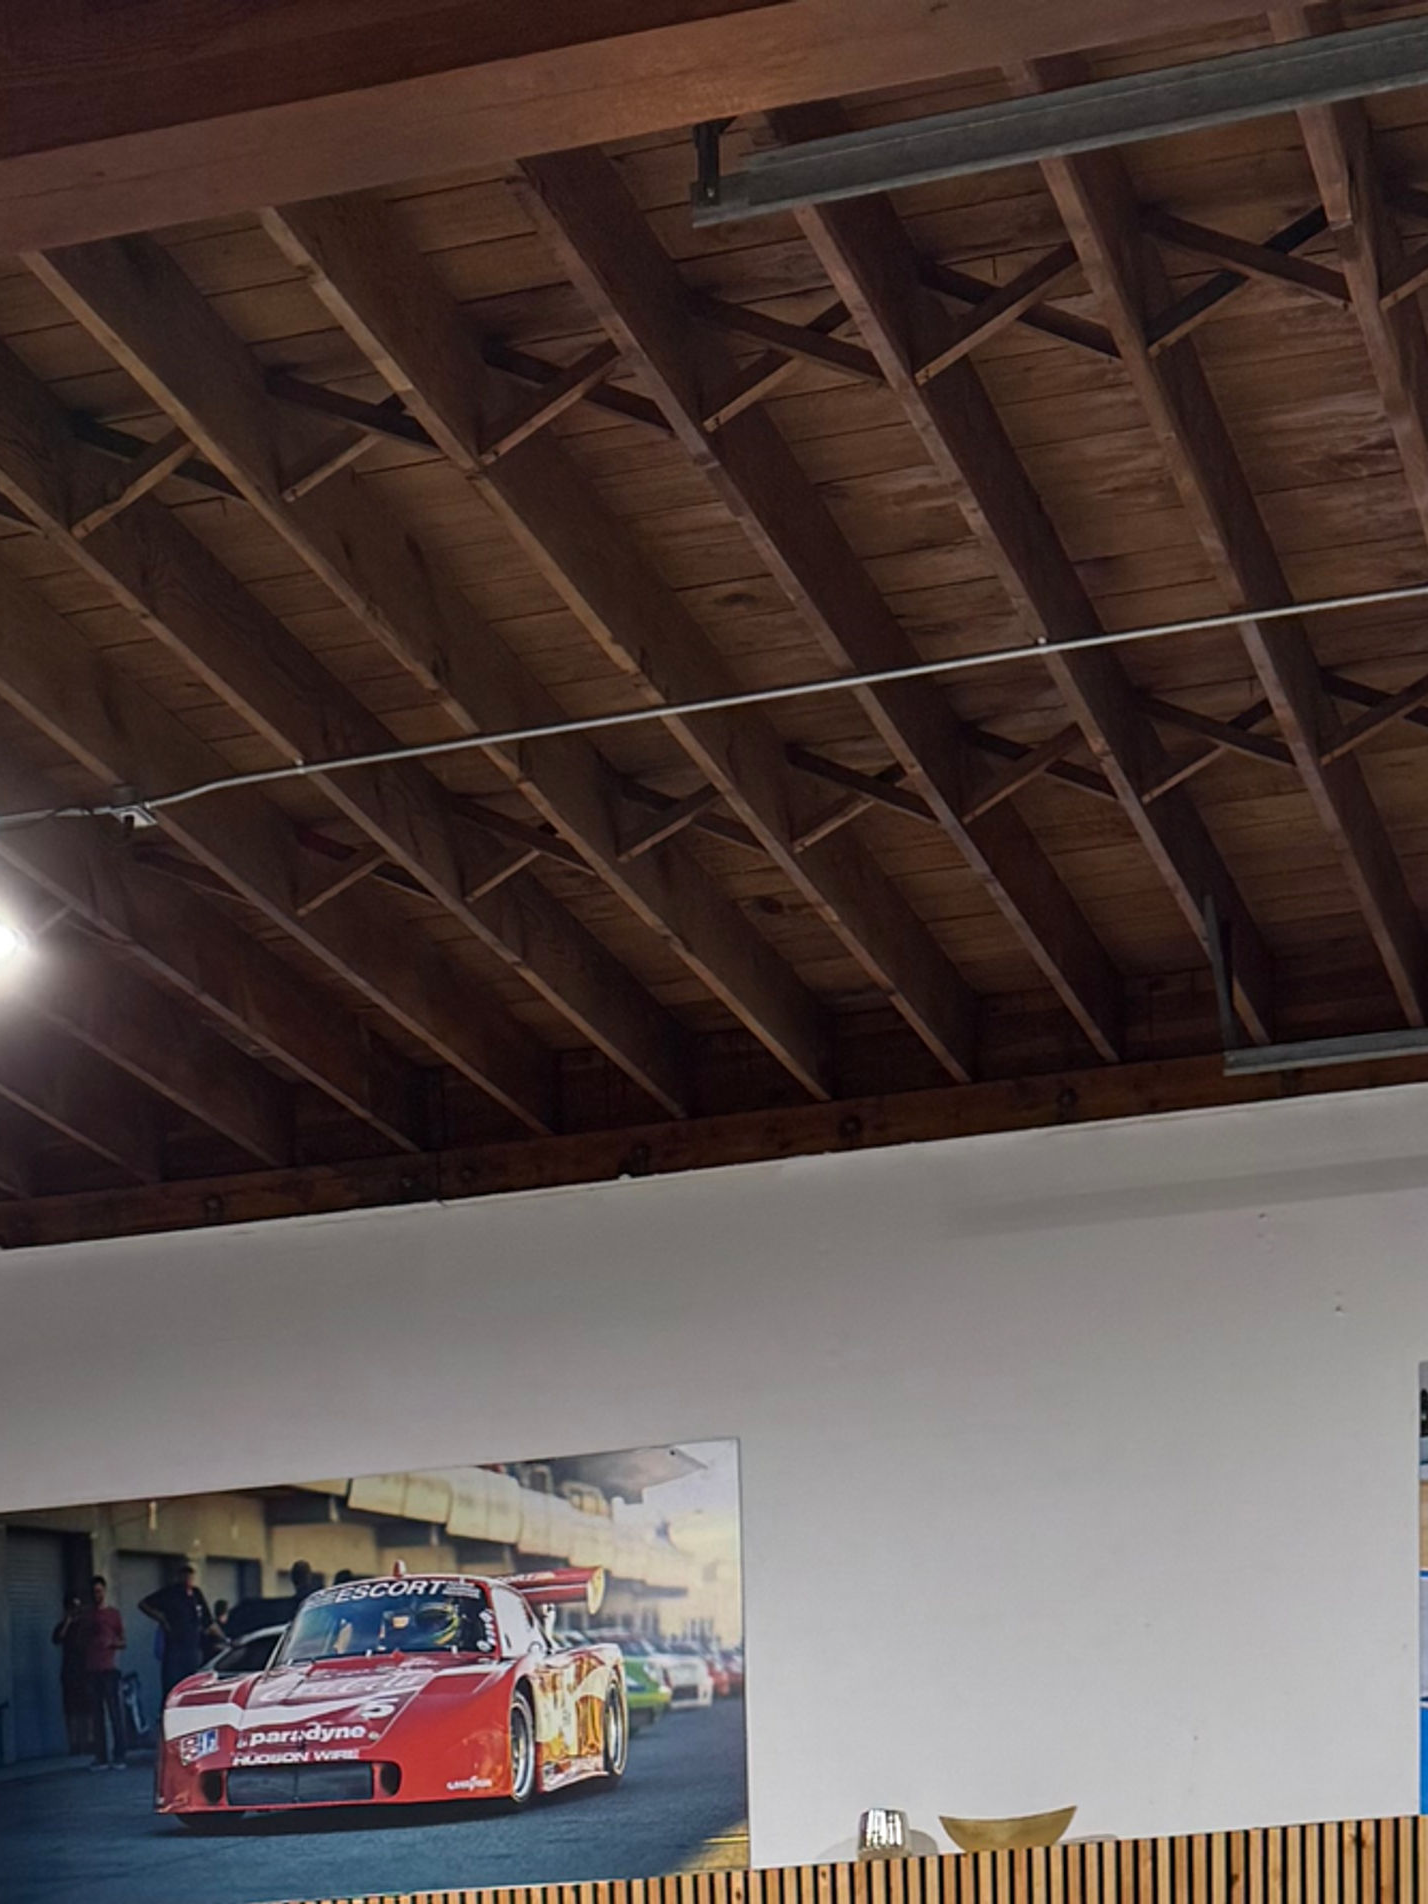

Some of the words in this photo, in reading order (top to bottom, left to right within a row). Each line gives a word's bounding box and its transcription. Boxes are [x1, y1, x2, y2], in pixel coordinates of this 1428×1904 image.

[336, 1580, 448, 1602] ESCORT
[249, 1721, 366, 1747] paradyne
[232, 1752, 309, 1767] HUDSON
[312, 1749, 360, 1761] WIRE
